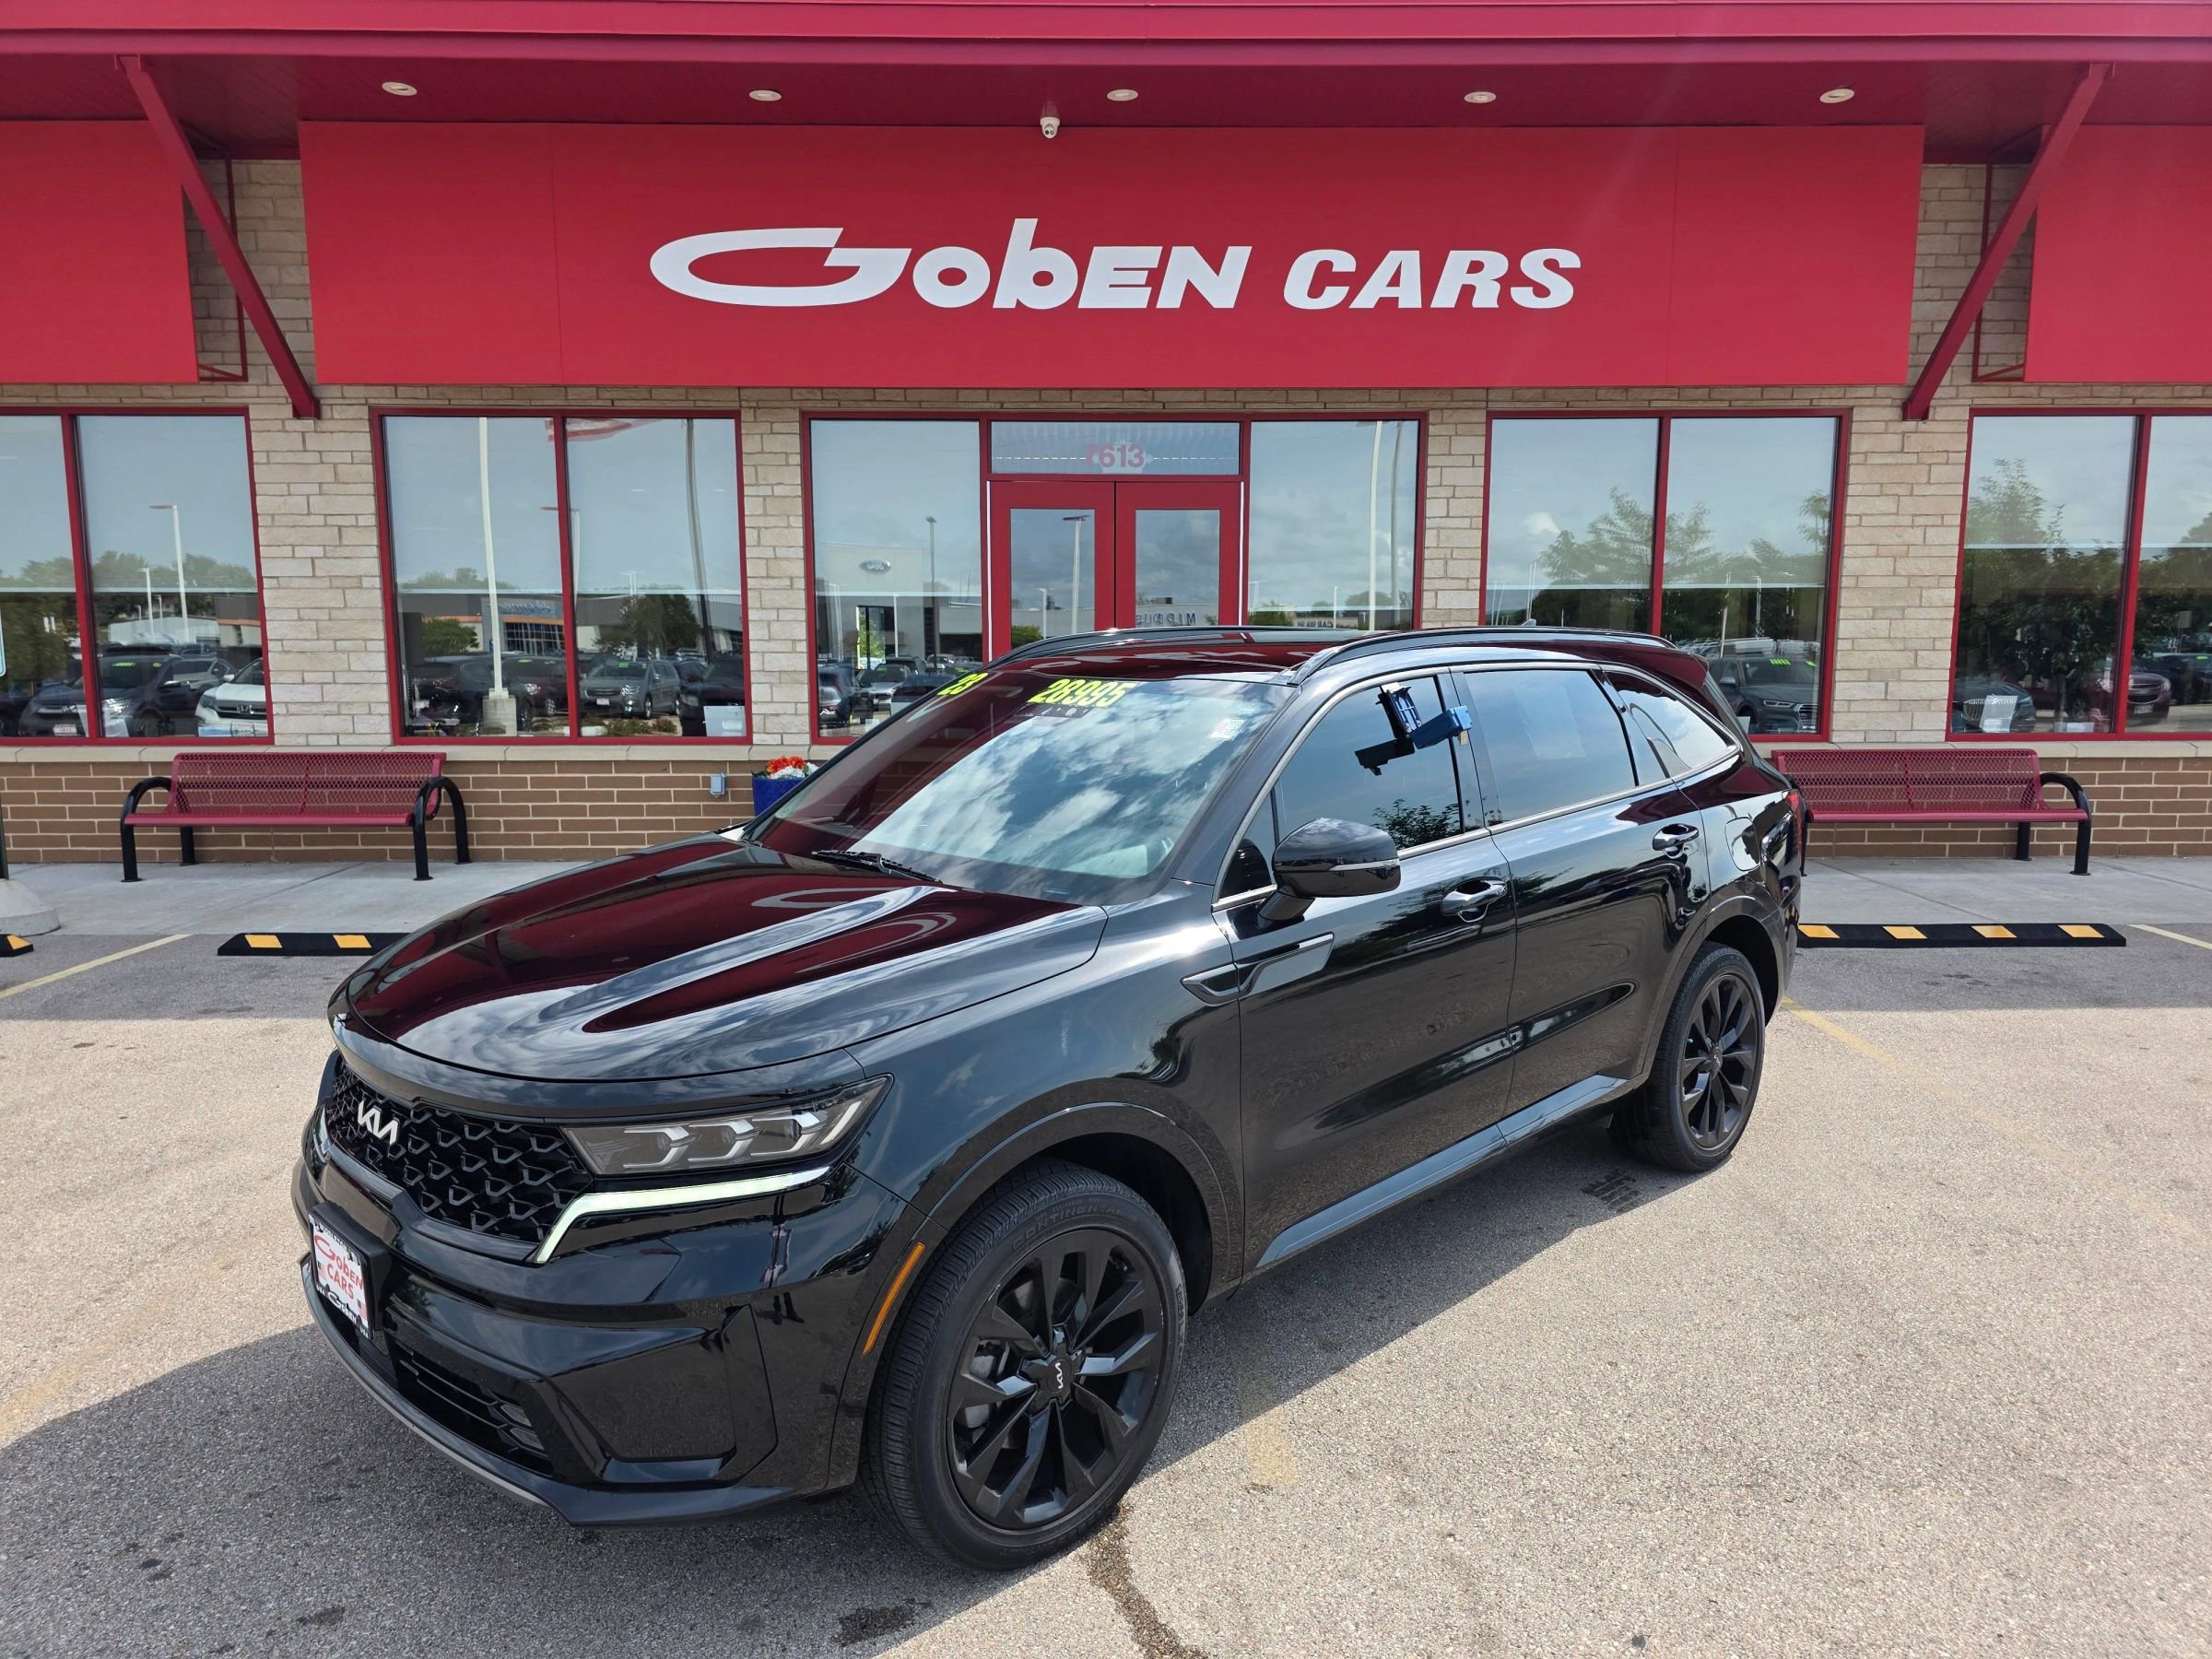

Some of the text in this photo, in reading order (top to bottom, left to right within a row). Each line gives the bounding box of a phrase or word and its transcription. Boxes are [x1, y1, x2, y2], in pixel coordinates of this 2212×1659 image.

[1283, 248, 1582, 310] CARS
[1083, 443, 1146, 468] 7613
[936, 672, 989, 696] 23
[1026, 678, 1138, 709] 28995
[326, 1263, 355, 1300] CARS
